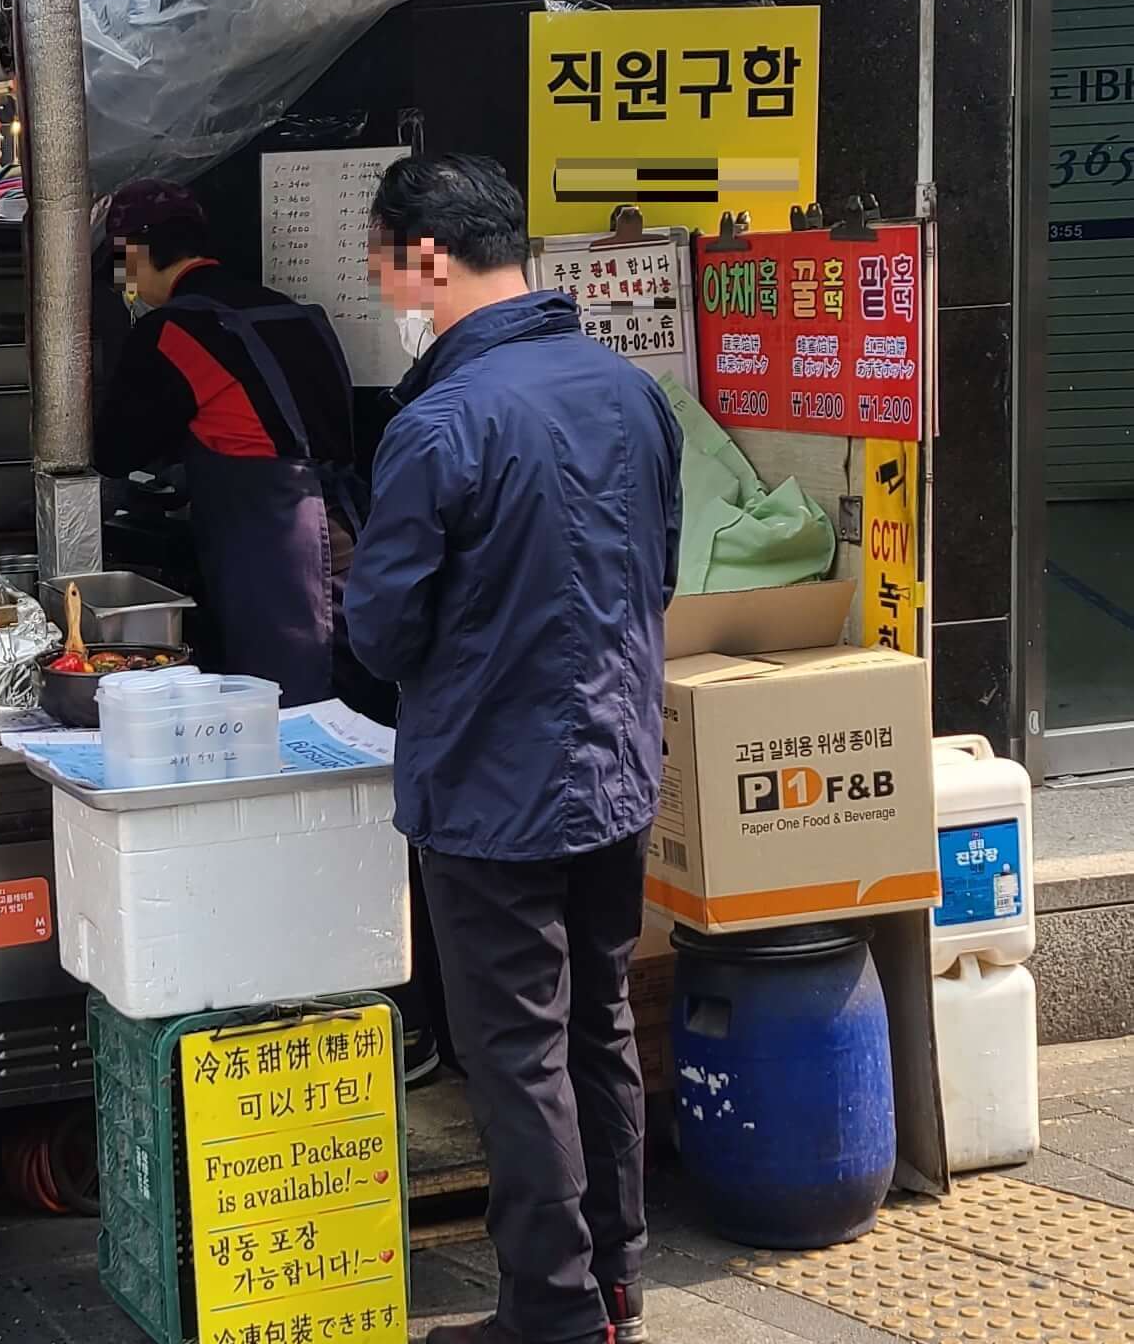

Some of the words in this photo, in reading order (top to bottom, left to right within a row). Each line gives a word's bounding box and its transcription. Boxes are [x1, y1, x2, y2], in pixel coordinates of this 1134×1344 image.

[547, 45, 802, 123] 직원구함
[554, 262, 582, 282] 주문
[589, 258, 618, 279] 판매
[626, 254, 670, 275] 합니다
[702, 260, 756, 318] 야채
[758, 257, 778, 319] 호떡
[790, 258, 818, 320] 꿀
[822, 257, 845, 322] 호떡
[890, 252, 914, 322] 호떡
[871, 518, 910, 565] CCTV
[735, 741, 765, 764] 고급
[769, 736, 813, 760] 일회용
[817, 731, 847, 756] 위생
[849, 725, 893, 752] 종이컵
[741, 820, 775, 837] Paper
[776, 816, 800, 831] One
[802, 813, 831, 830] Food
[832, 811, 842, 825] &
[844, 806, 896, 828] Beverage
[204, 1154, 285, 1183] Frozen
[290, 1135, 384, 1168] Package
[217, 1189, 237, 1215] is
[209, 1231, 260, 1267] 냉동
[268, 1220, 319, 1254] 포장
